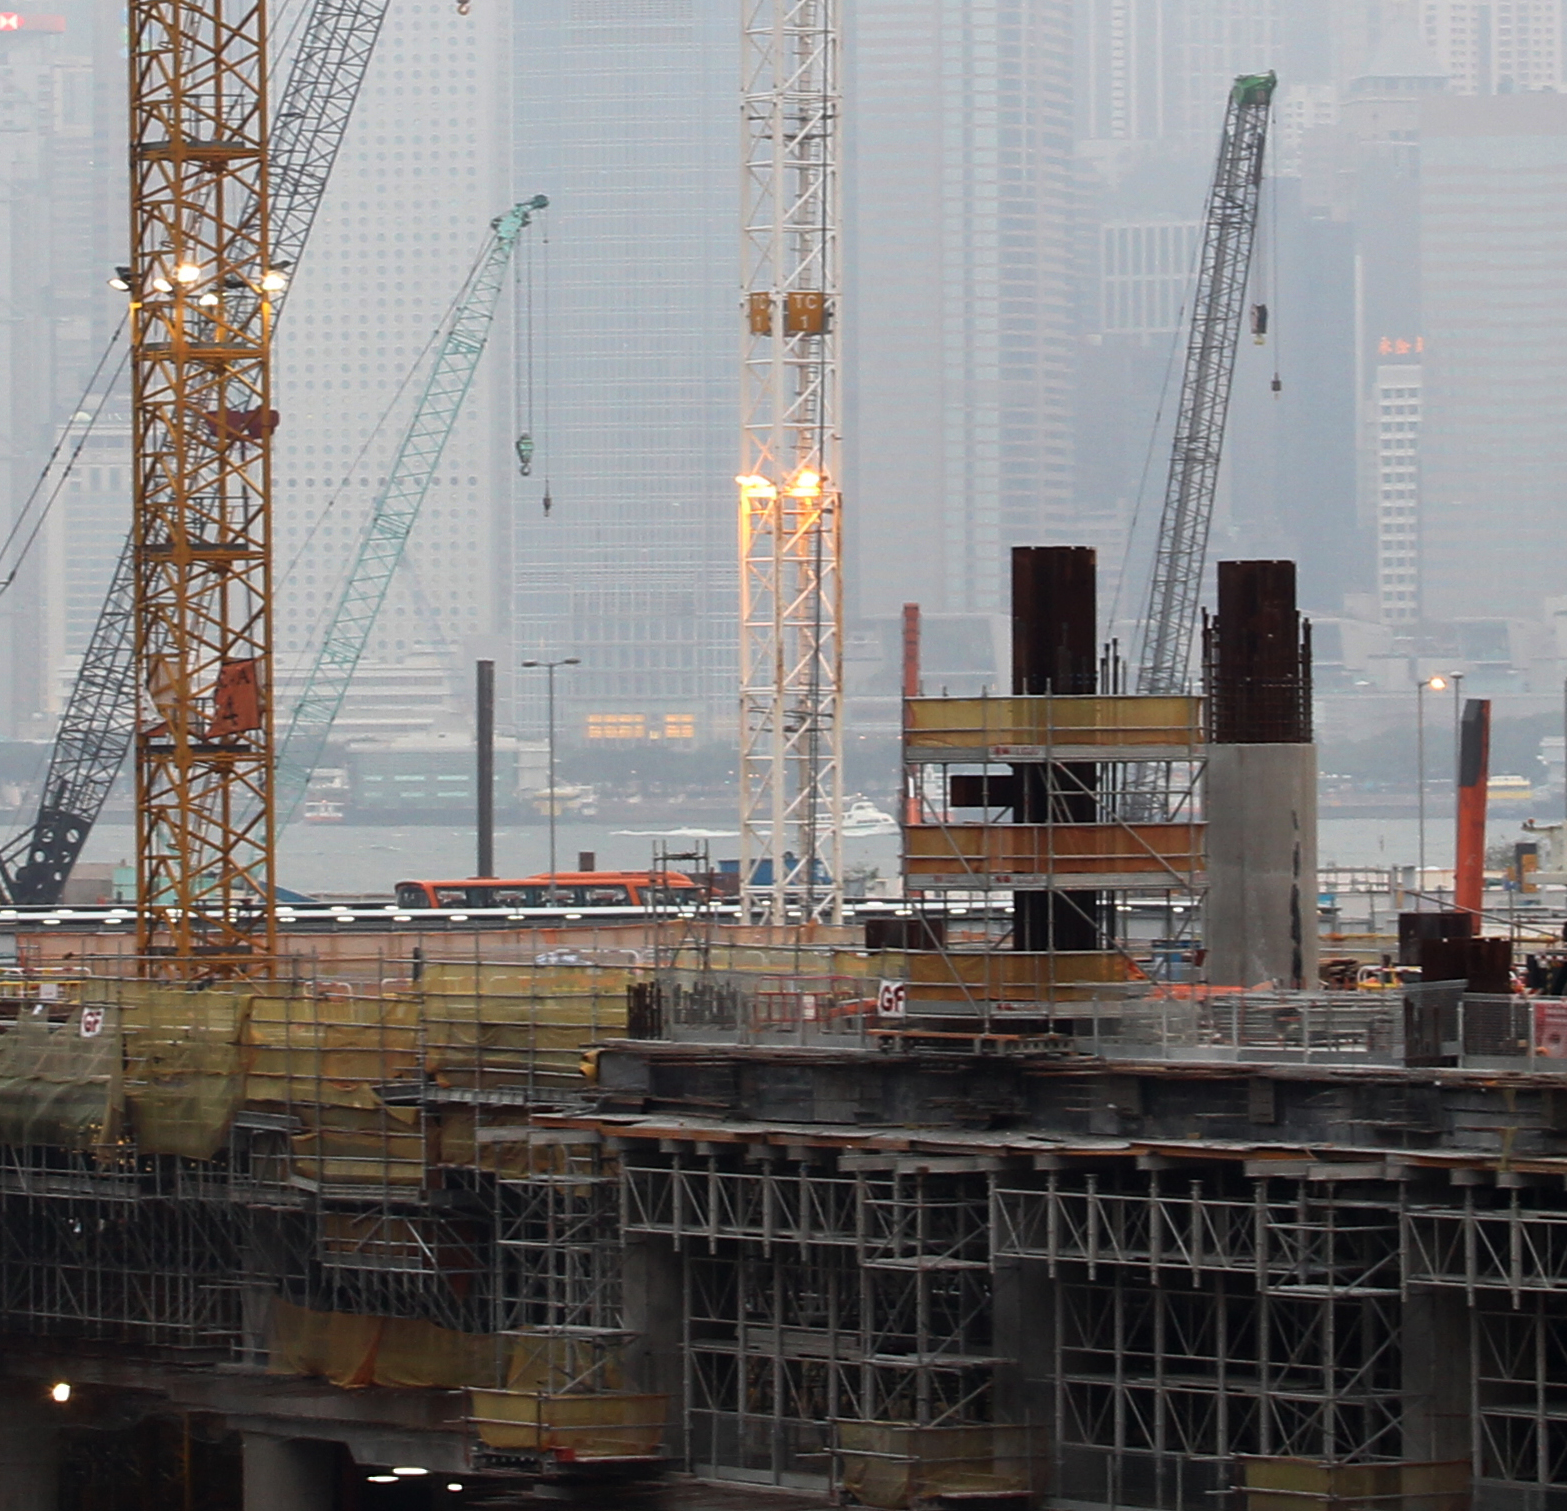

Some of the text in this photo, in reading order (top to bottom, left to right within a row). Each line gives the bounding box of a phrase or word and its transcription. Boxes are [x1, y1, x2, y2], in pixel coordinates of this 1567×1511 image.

[793, 294, 818, 310] TC
[800, 315, 808, 329] 1
[881, 985, 905, 1012] GF
